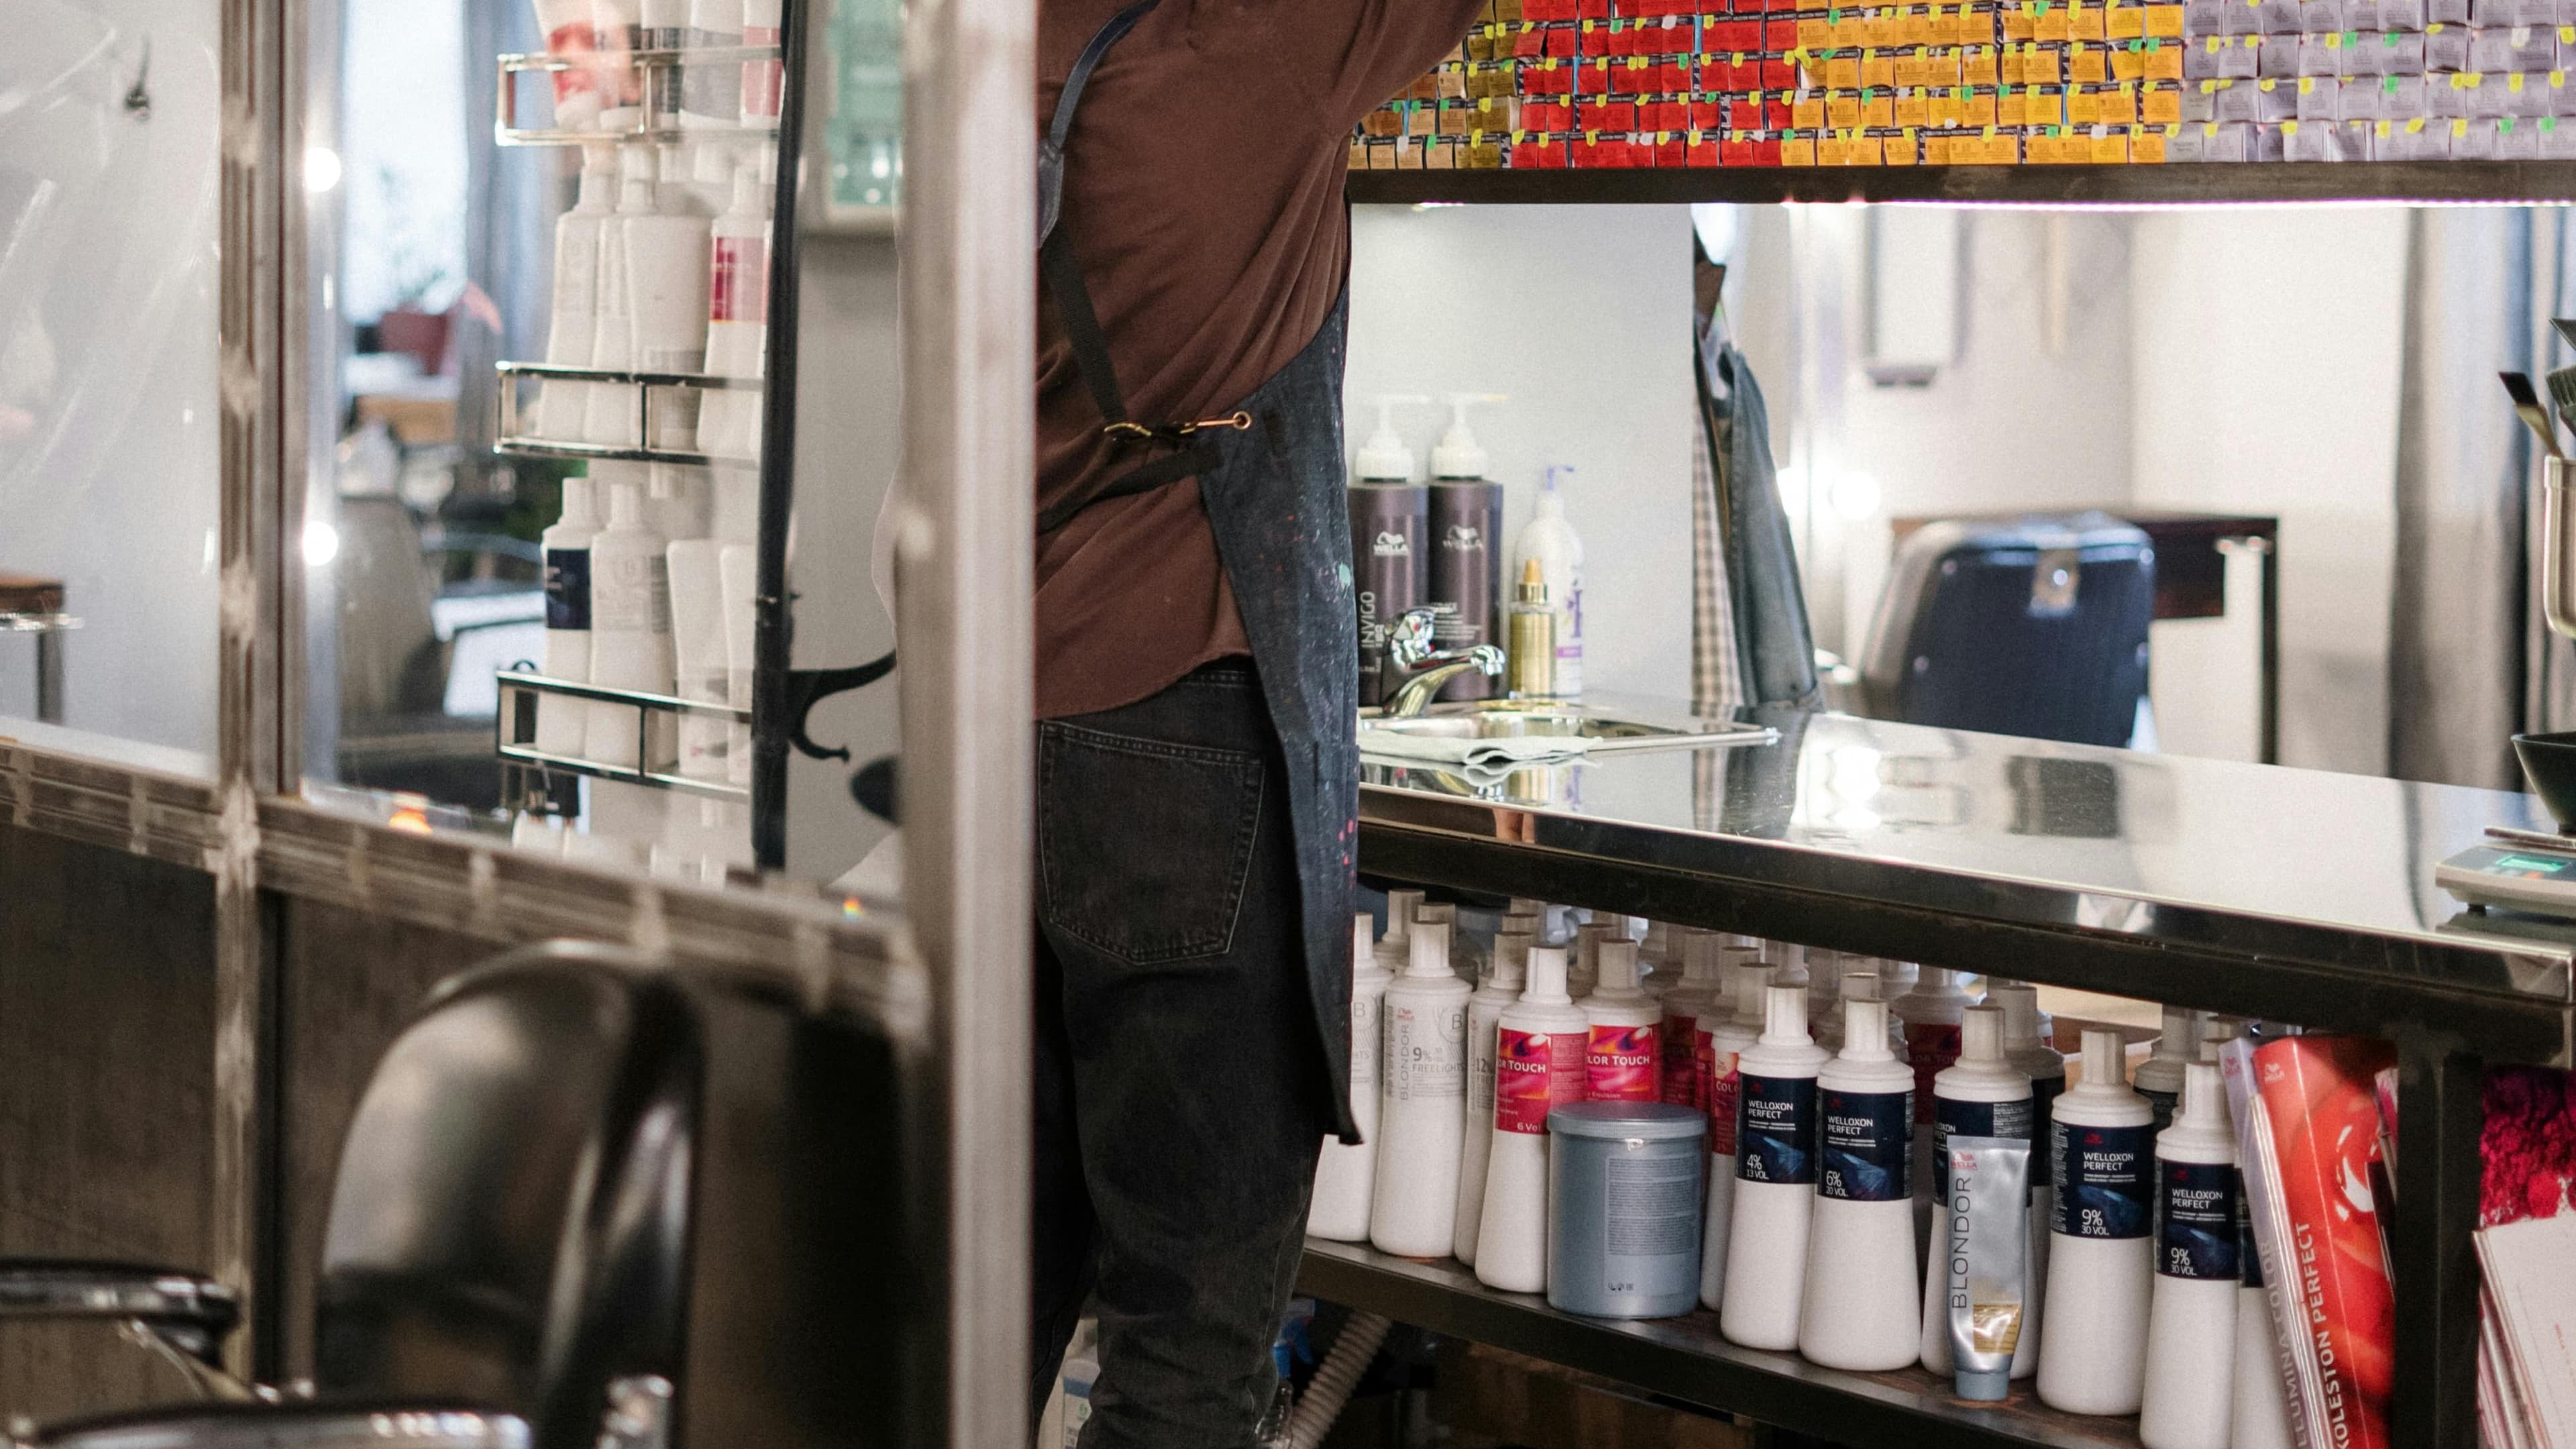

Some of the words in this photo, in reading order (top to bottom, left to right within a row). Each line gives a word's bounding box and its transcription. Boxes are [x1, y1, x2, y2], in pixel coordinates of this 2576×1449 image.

[1360, 591, 1375, 648] INVIGO
[1400, 1024, 1409, 1101] BLONDOR
[1509, 1060, 1546, 1073] TOUCH
[1588, 1055, 1609, 1065] LOR
[1612, 1055, 1650, 1066] TOUCH
[1748, 1099, 1794, 1111] WELLOXON
[1748, 1108, 1782, 1119] PERFECT
[1517, 1122, 1524, 1130] 6
[1827, 1114, 1874, 1127] WELLOXON
[1827, 1124, 1862, 1135] PERFECT
[1747, 1154, 1763, 1170] 4%
[2083, 1151, 2134, 1162] WELLOXON
[2083, 1161, 2123, 1171] PERFECT
[1747, 1169, 1754, 1178] 13
[1826, 1170, 1842, 1187] 6%
[2171, 1188, 2223, 1200] WELLOXON
[2171, 1198, 2210, 1209] PERFECT
[2082, 1209, 2103, 1226] 9%
[2081, 1225, 2092, 1234] 30
[1951, 1177, 1972, 1309] BLONDOR
[2171, 1246, 2190, 1266] 9%
[2171, 1265, 2180, 1274] 30
[2296, 1222, 2327, 1324] PERFECT
[2278, 1333, 2308, 1448] LLUMINA
